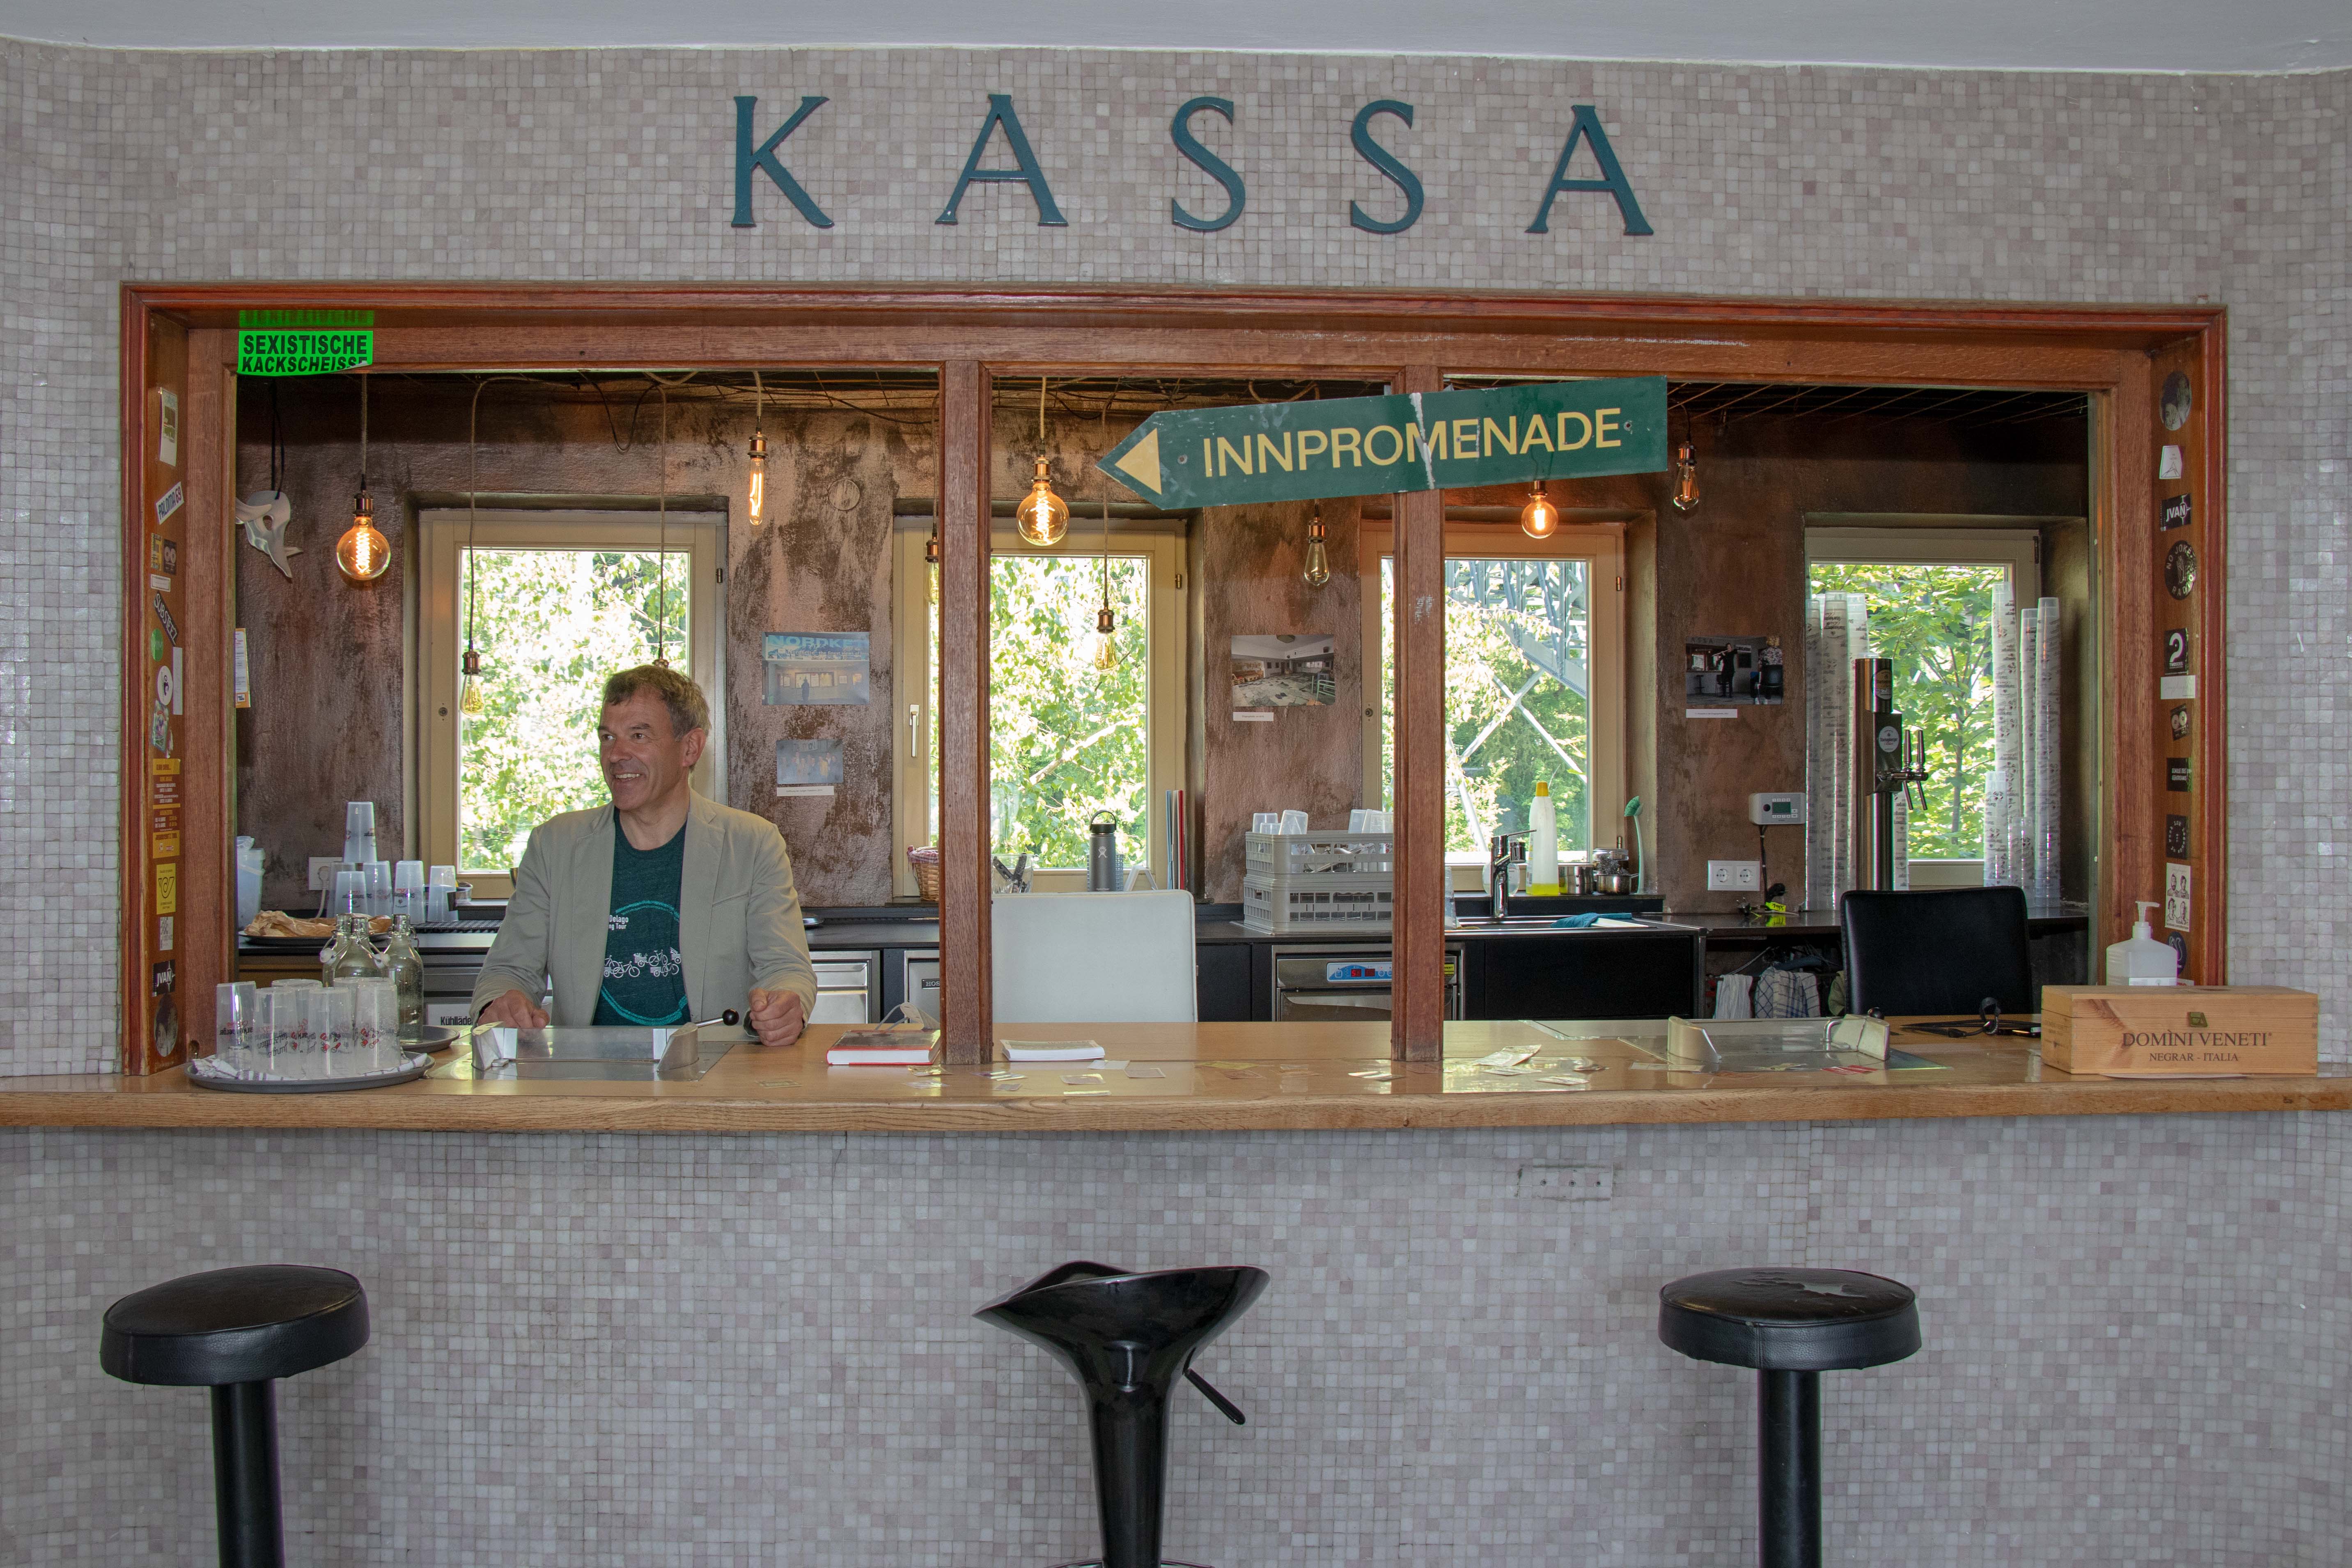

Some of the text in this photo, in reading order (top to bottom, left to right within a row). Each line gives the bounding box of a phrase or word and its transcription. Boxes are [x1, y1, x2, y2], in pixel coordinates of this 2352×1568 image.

[733, 94, 1654, 236] KASSA
[243, 334, 367, 355] SEXISTISCHE
[1203, 407, 1622, 478] INNPROMENADE
[158, 486, 182, 520] PALOMA 69
[610, 915, 629, 924] Delago
[2123, 1029, 2194, 1046] DOMÌNI
[2150, 1052, 2194, 1061] NEGRAR
[2203, 1052, 2238, 1061] ITALIA
